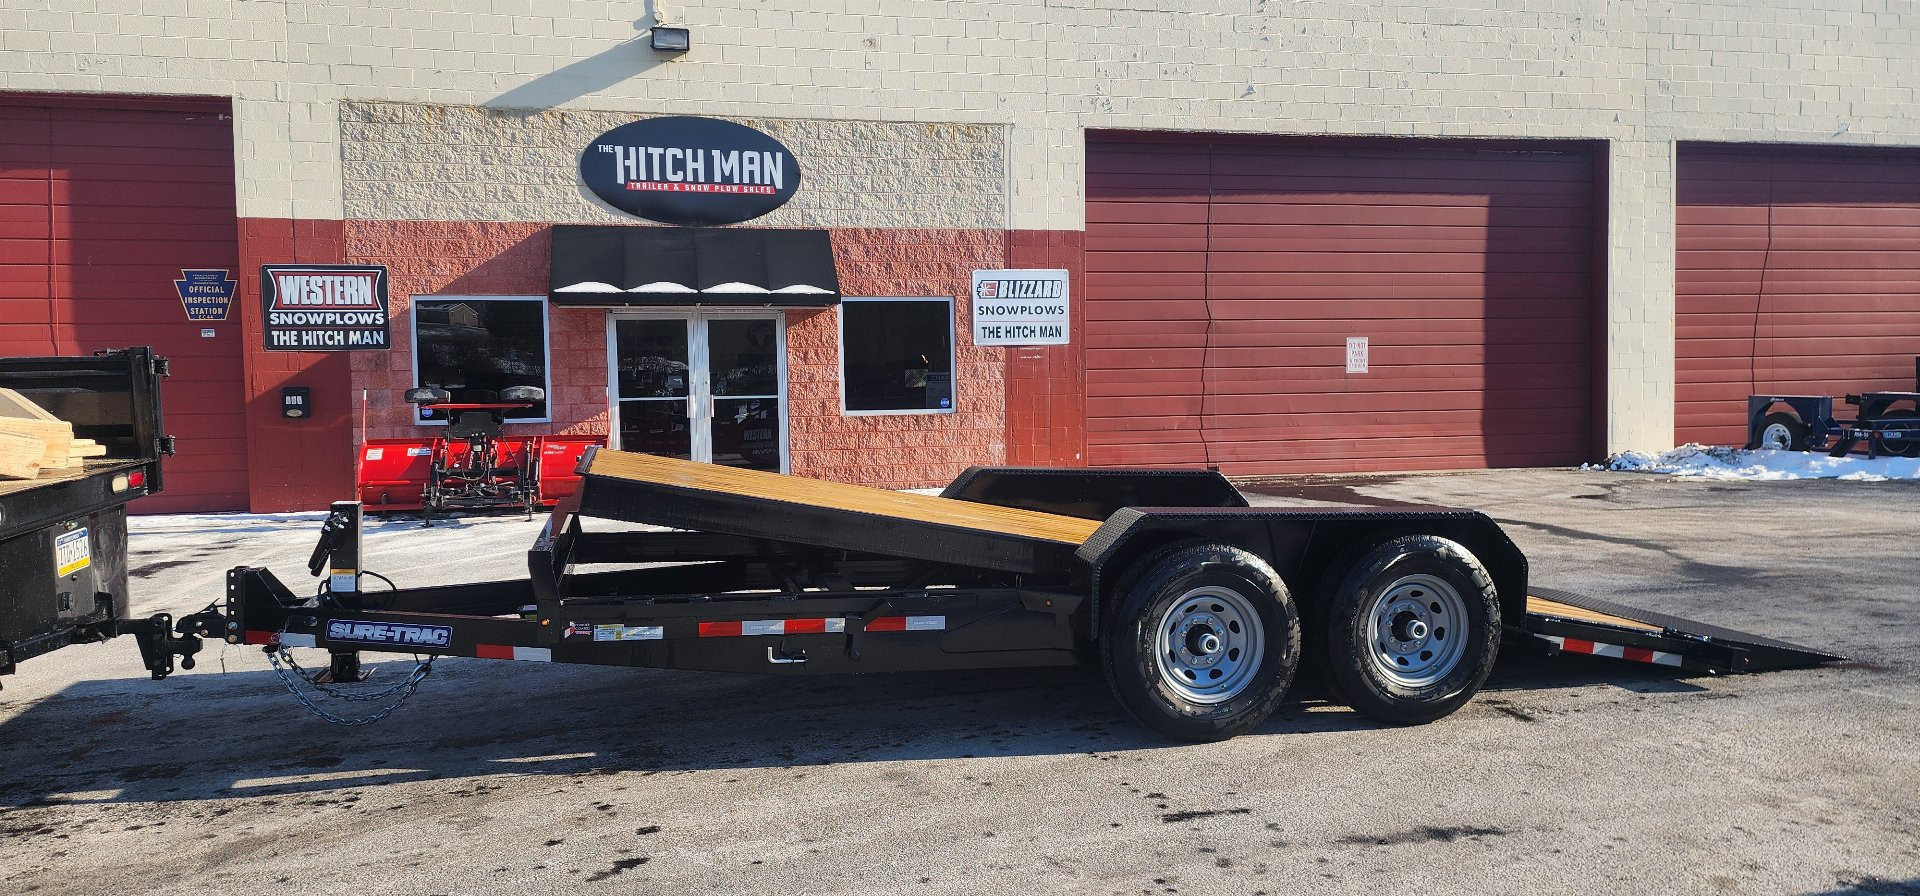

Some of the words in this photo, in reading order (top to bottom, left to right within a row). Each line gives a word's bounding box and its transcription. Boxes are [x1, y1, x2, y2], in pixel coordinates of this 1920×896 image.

[598, 144, 614, 153] THE
[614, 146, 705, 184] HITCH
[712, 150, 783, 189] MAN
[630, 182, 669, 190] TRAILER
[673, 183, 680, 191] &
[685, 184, 710, 192] SNOW
[714, 185, 739, 193] PLOW
[743, 186, 772, 194] SALES
[188, 286, 225, 294] OFFICIAL
[279, 276, 372, 305] WESTERN
[998, 280, 1062, 298] BLIZZARD
[978, 306, 1065, 316] SNOWPLOWS
[269, 312, 385, 325] SNOWPLOWS
[271, 330, 298, 346] THE
[302, 330, 344, 346] HITCH
[348, 330, 384, 346] MAN
[982, 326, 1002, 338] THE
[1005, 326, 1036, 338] HITCH
[1040, 326, 1062, 338] MAN
[330, 622, 449, 646] SURE-TRAC
